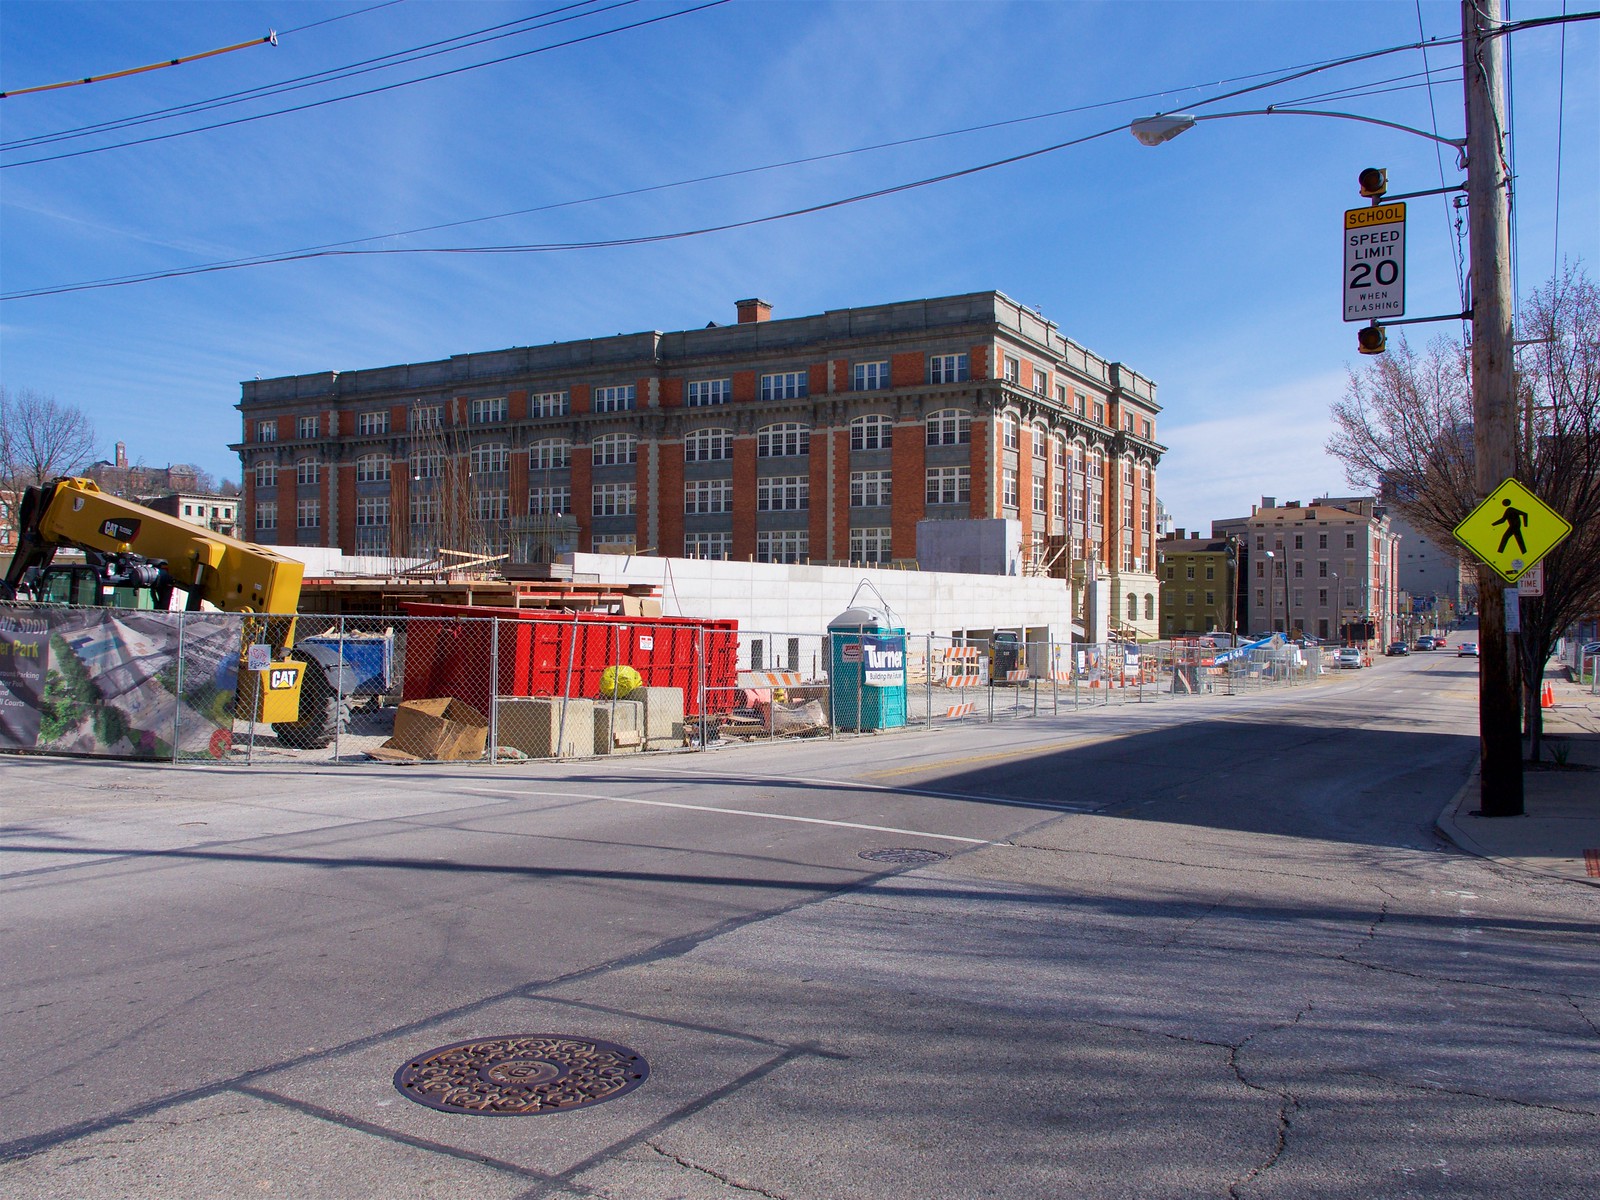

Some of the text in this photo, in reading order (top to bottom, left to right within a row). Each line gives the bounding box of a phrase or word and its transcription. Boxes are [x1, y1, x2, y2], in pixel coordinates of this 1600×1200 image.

[1349, 207, 1402, 225] SCHOOL
[1350, 230, 1400, 246] SPEED
[1355, 245, 1394, 260] LIMIT
[1349, 259, 1399, 289] 20
[1359, 291, 1388, 301] WHEN
[1348, 301, 1399, 313] FLASHING
[104, 521, 119, 538] CAT
[1520, 580, 1537, 588] TIME
[18, 617, 48, 635] SOON
[12, 639, 39, 658] Park
[864, 644, 903, 669] Turner
[17, 671, 40, 681] Parking
[271, 670, 296, 689] CAT
[869, 672, 887, 681] Building
[4, 698, 25, 708] Courts
